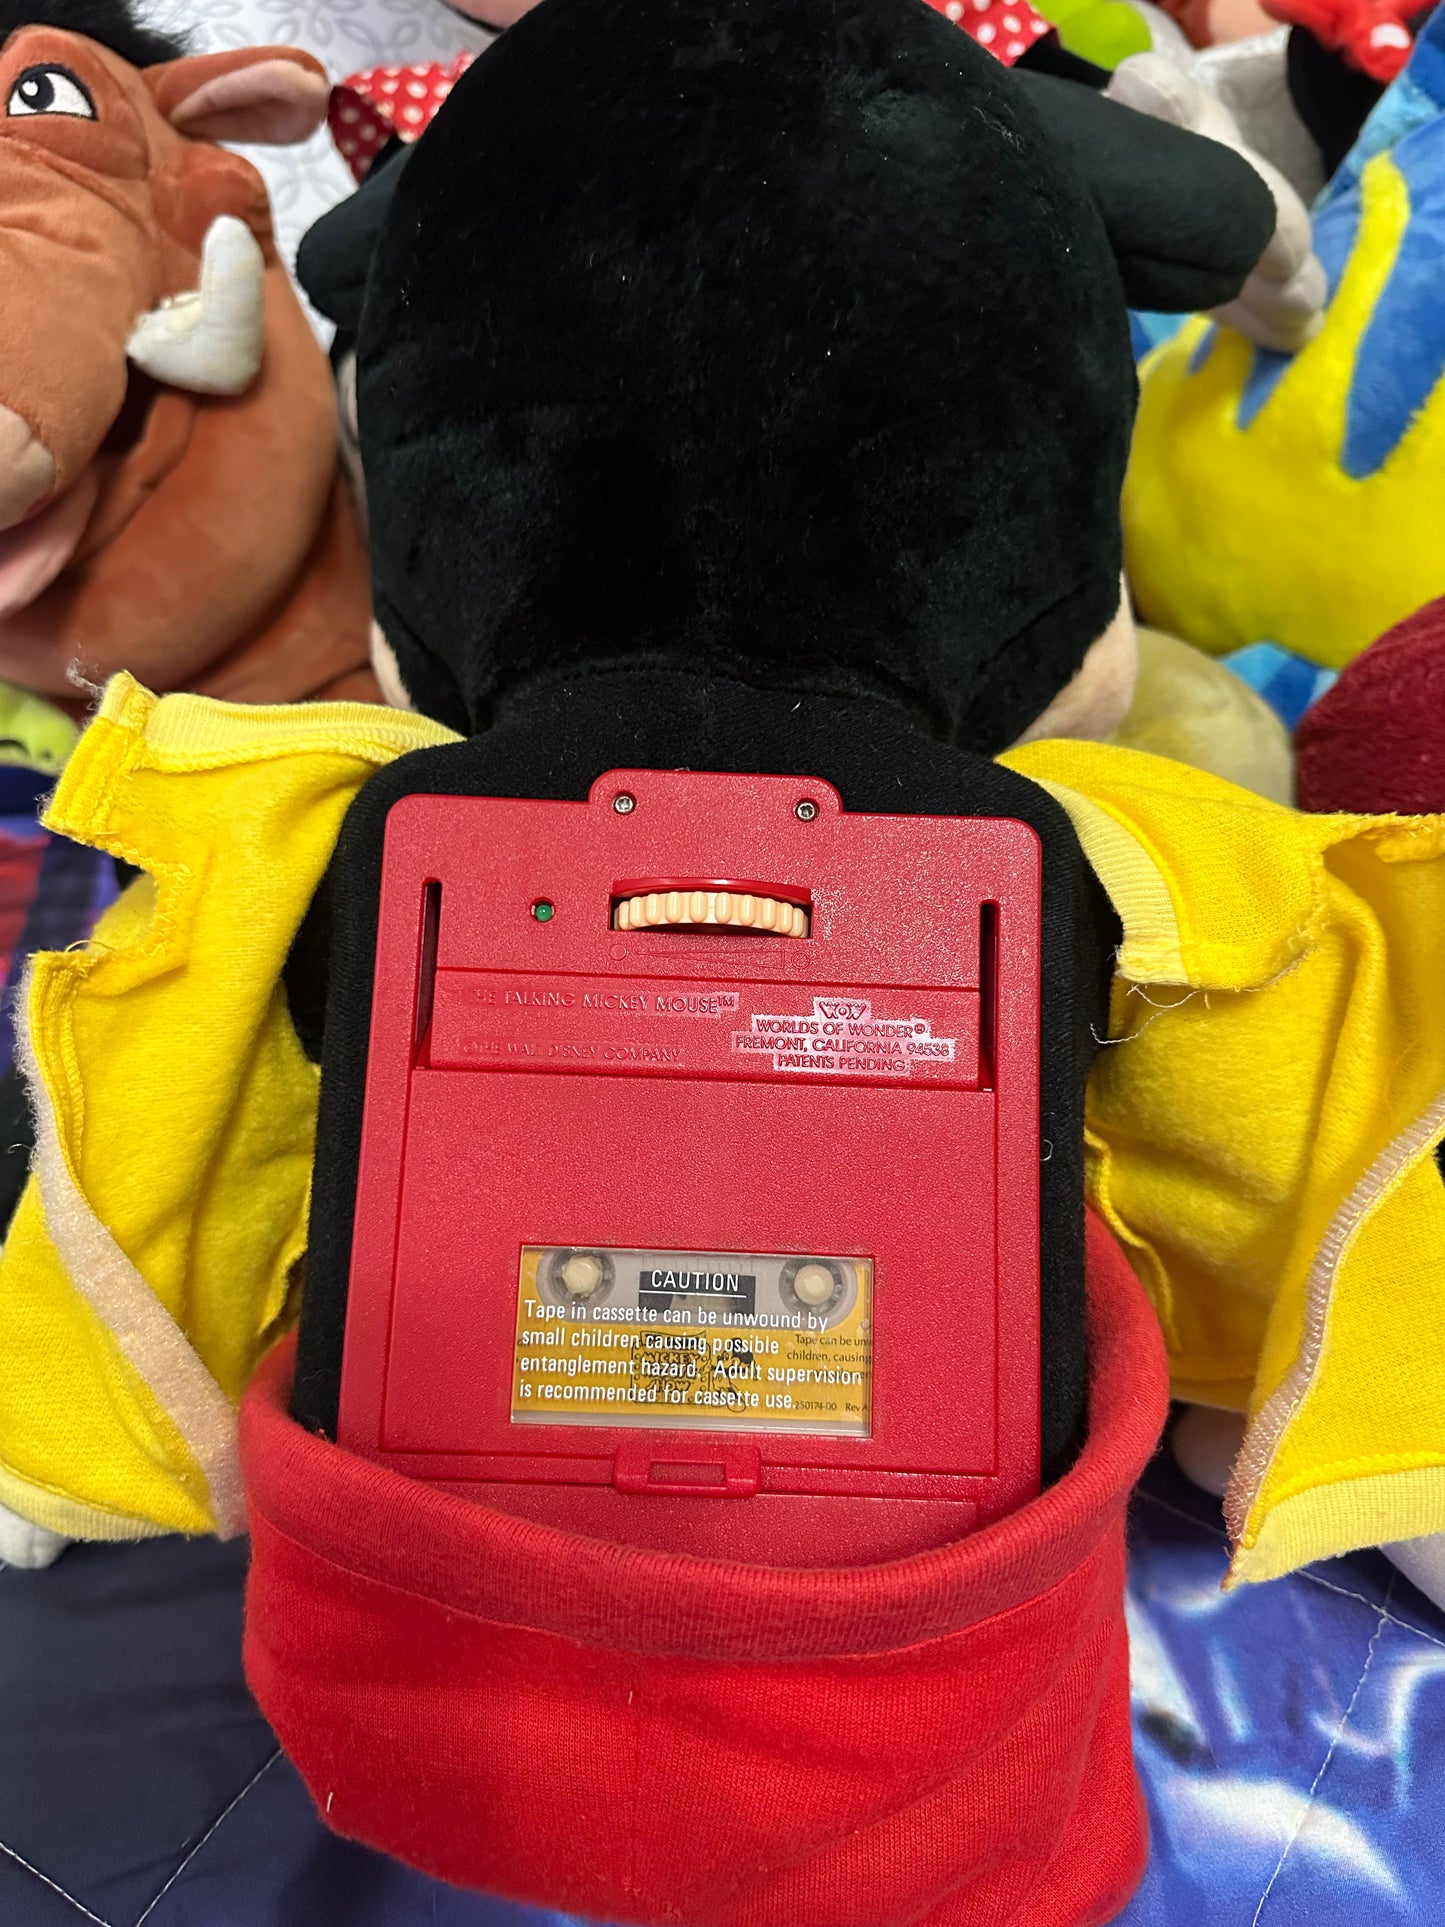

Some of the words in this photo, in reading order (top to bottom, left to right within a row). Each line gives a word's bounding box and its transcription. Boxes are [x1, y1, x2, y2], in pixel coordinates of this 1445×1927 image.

[505, 991, 575, 1007] TALKING
[582, 993, 649, 1010] MICKEY
[756, 1019, 819, 1035] WORLDS
[823, 1021, 843, 1036] OF
[548, 1045, 599, 1059] DISNEY
[603, 1046, 682, 1062] COMPANY
[736, 1036, 807, 1052] FREMONT,
[812, 1038, 902, 1054] CALIFORNIA
[906, 1043, 950, 1057] 94538
[778, 1053, 834, 1069] PATENTS
[839, 1056, 905, 1071] PENDING
[651, 1269, 740, 1292] CAUTION
[524, 1300, 565, 1322] Tape
[571, 1302, 587, 1319] in
[593, 1306, 658, 1322] cassette
[663, 1309, 691, 1323] can
[698, 1307, 716, 1324] be
[723, 1311, 800, 1329] unwound
[808, 1312, 828, 1333] by
[522, 1327, 565, 1346] small
[571, 1328, 640, 1348] children
[646, 1331, 706, 1354] causing
[712, 1335, 779, 1356] possible
[795, 1334, 817, 1346] Tape
[819, 1337, 837, 1345] can
[840, 1336, 852, 1345] be
[642, 1351, 700, 1365] MICKEY
[787, 1350, 831, 1362] children,
[520, 1354, 634, 1377] entanglement
[641, 1356, 702, 1378] hazard.
[713, 1359, 761, 1380] Adult
[767, 1364, 862, 1386] supervision
[520, 1379, 532, 1397] is
[537, 1383, 656, 1403] recommended
[664, 1384, 688, 1403] for
[694, 1389, 759, 1407] cassette
[765, 1393, 796, 1410] use.
[845, 1403, 859, 1412] Rev
